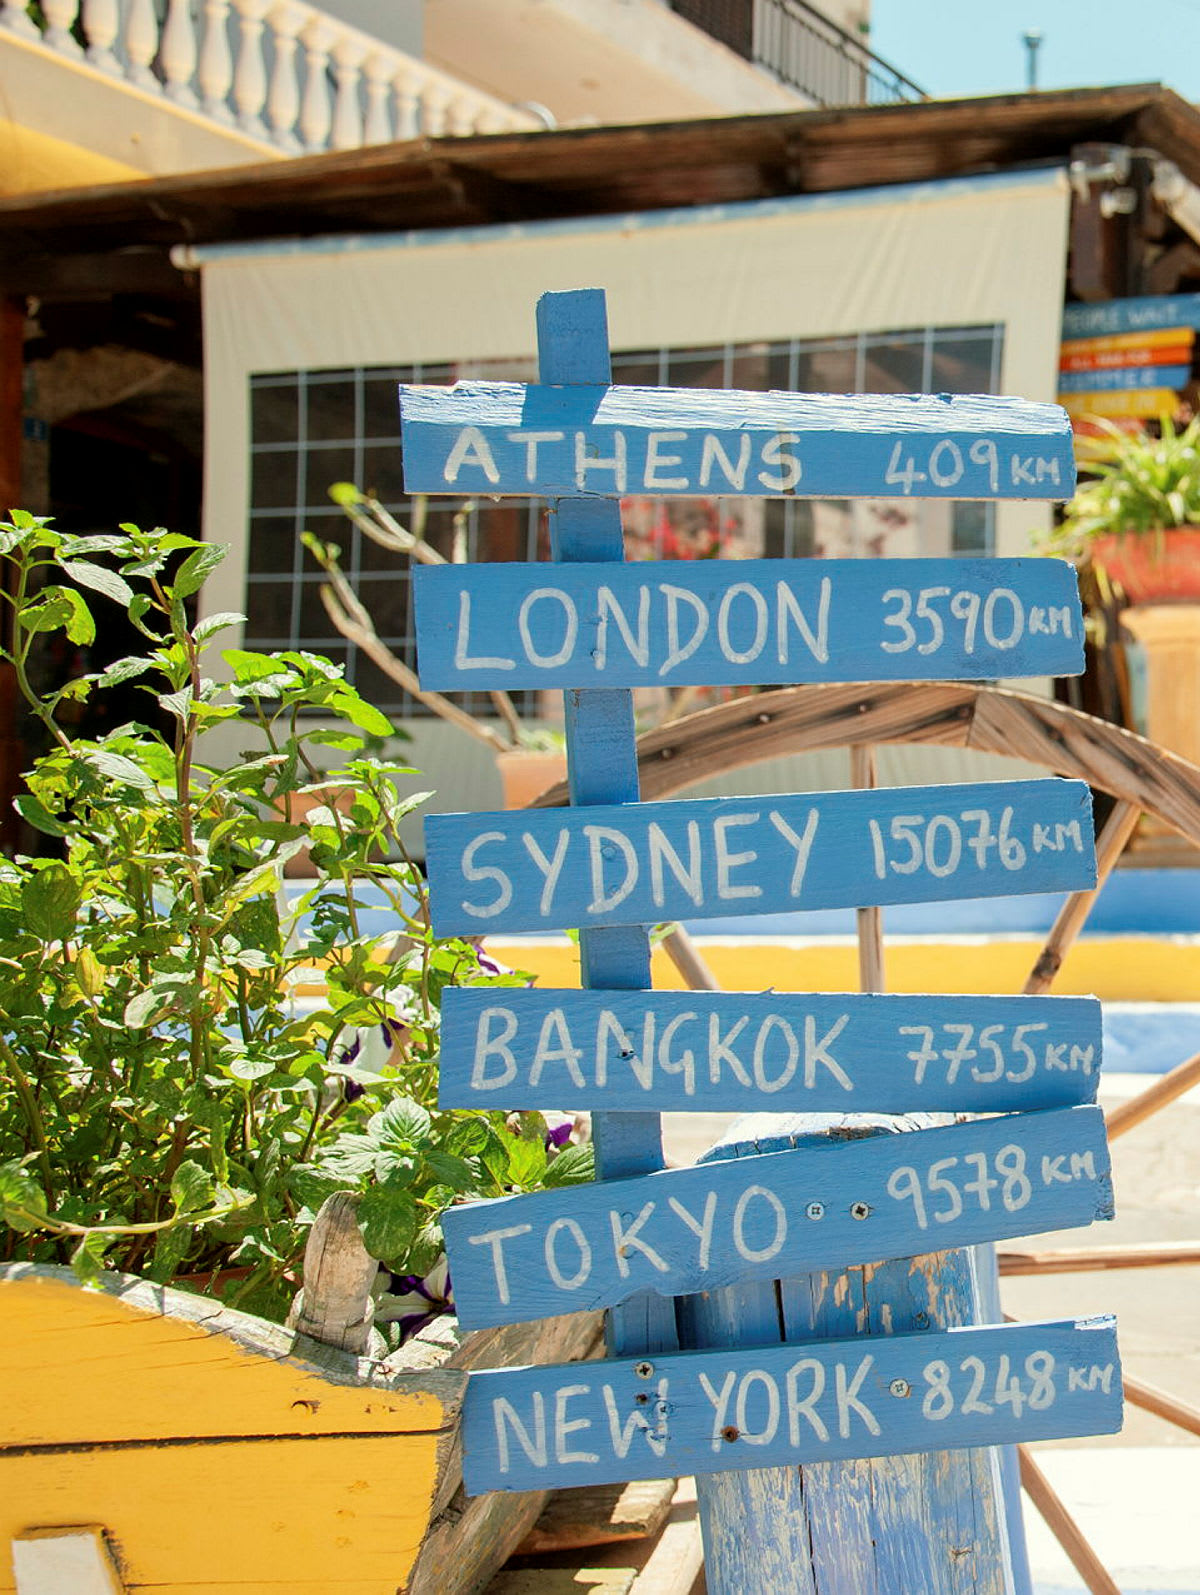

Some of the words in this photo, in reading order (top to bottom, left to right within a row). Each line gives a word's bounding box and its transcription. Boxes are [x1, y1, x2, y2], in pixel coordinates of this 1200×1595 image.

[444, 426, 802, 493] ATHENS
[885, 438, 999, 494] 409
[1010, 453, 1062, 486] KM
[455, 577, 830, 675] LONDON
[880, 586, 1023, 656] 3590
[1029, 604, 1073, 639] KM
[461, 808, 820, 918] SYDNEY
[869, 805, 1026, 879] 15076
[1033, 819, 1085, 853] KM
[471, 1007, 853, 1096] BANGKOK
[899, 1021, 1049, 1085] 7755
[1044, 1040, 1095, 1074] KM
[468, 1184, 788, 1304] TOKYO
[887, 1143, 1032, 1231] 9578
[1041, 1150, 1098, 1184] KM
[493, 1377, 670, 1474] NEW
[698, 1354, 882, 1453] YORK
[921, 1349, 1057, 1421] 8248
[1067, 1361, 1115, 1395] KM
